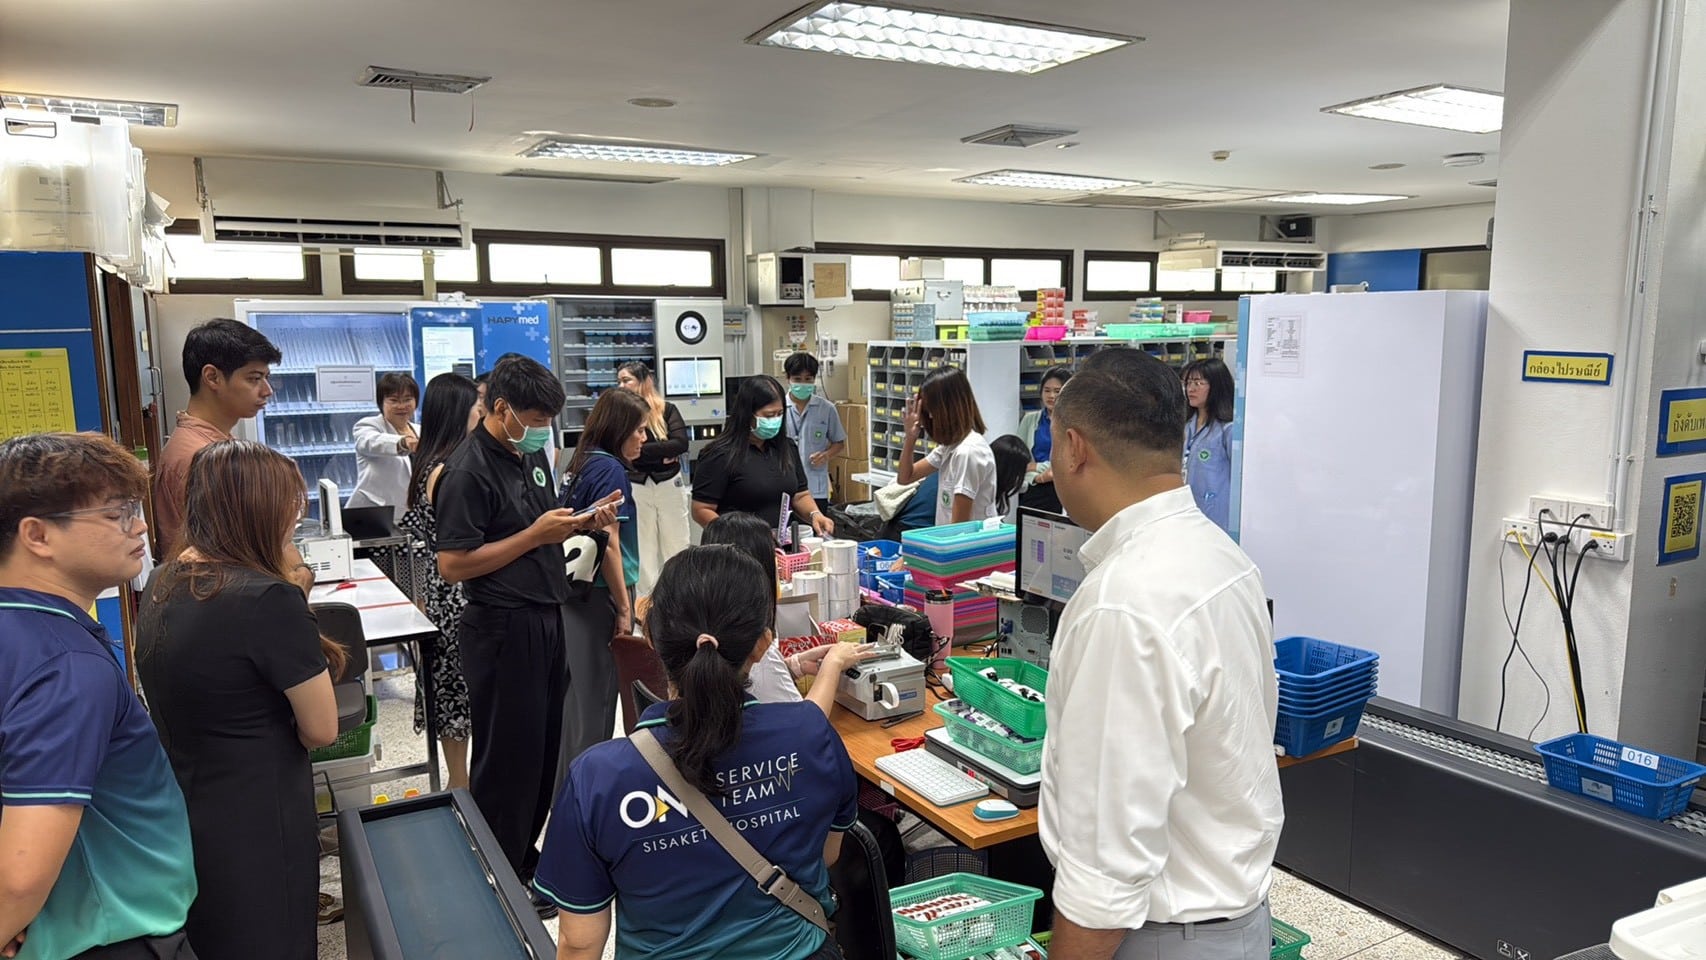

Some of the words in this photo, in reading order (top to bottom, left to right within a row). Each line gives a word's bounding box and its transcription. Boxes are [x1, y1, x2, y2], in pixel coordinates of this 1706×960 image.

[715, 752, 800, 788] SERVICE
[1627, 750, 1652, 766] 016
[643, 828, 708, 853] SISAKET
[730, 806, 801, 831] OSPITAL
